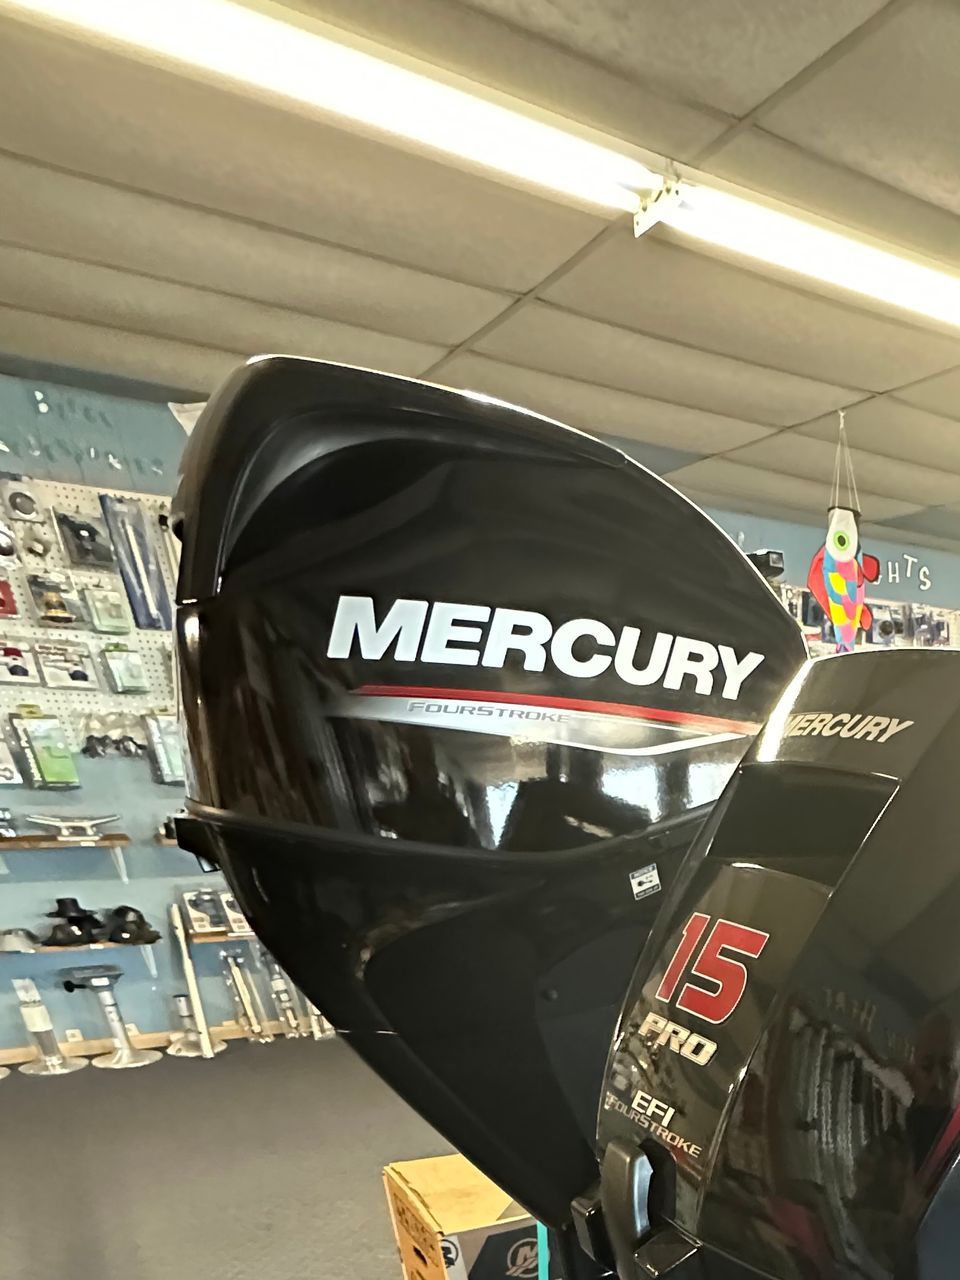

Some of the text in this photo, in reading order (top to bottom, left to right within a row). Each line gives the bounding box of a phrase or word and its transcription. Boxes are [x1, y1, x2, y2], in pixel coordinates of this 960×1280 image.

[873, 554, 932, 591] HTS
[326, 595, 765, 700] MERCURY
[407, 701, 571, 723] FOURSTROKE
[655, 912, 770, 1025] 15
[638, 1011, 718, 1066] PRO
[607, 1095, 703, 1158] FOURSTROKE
[631, 1089, 677, 1128] EFI
